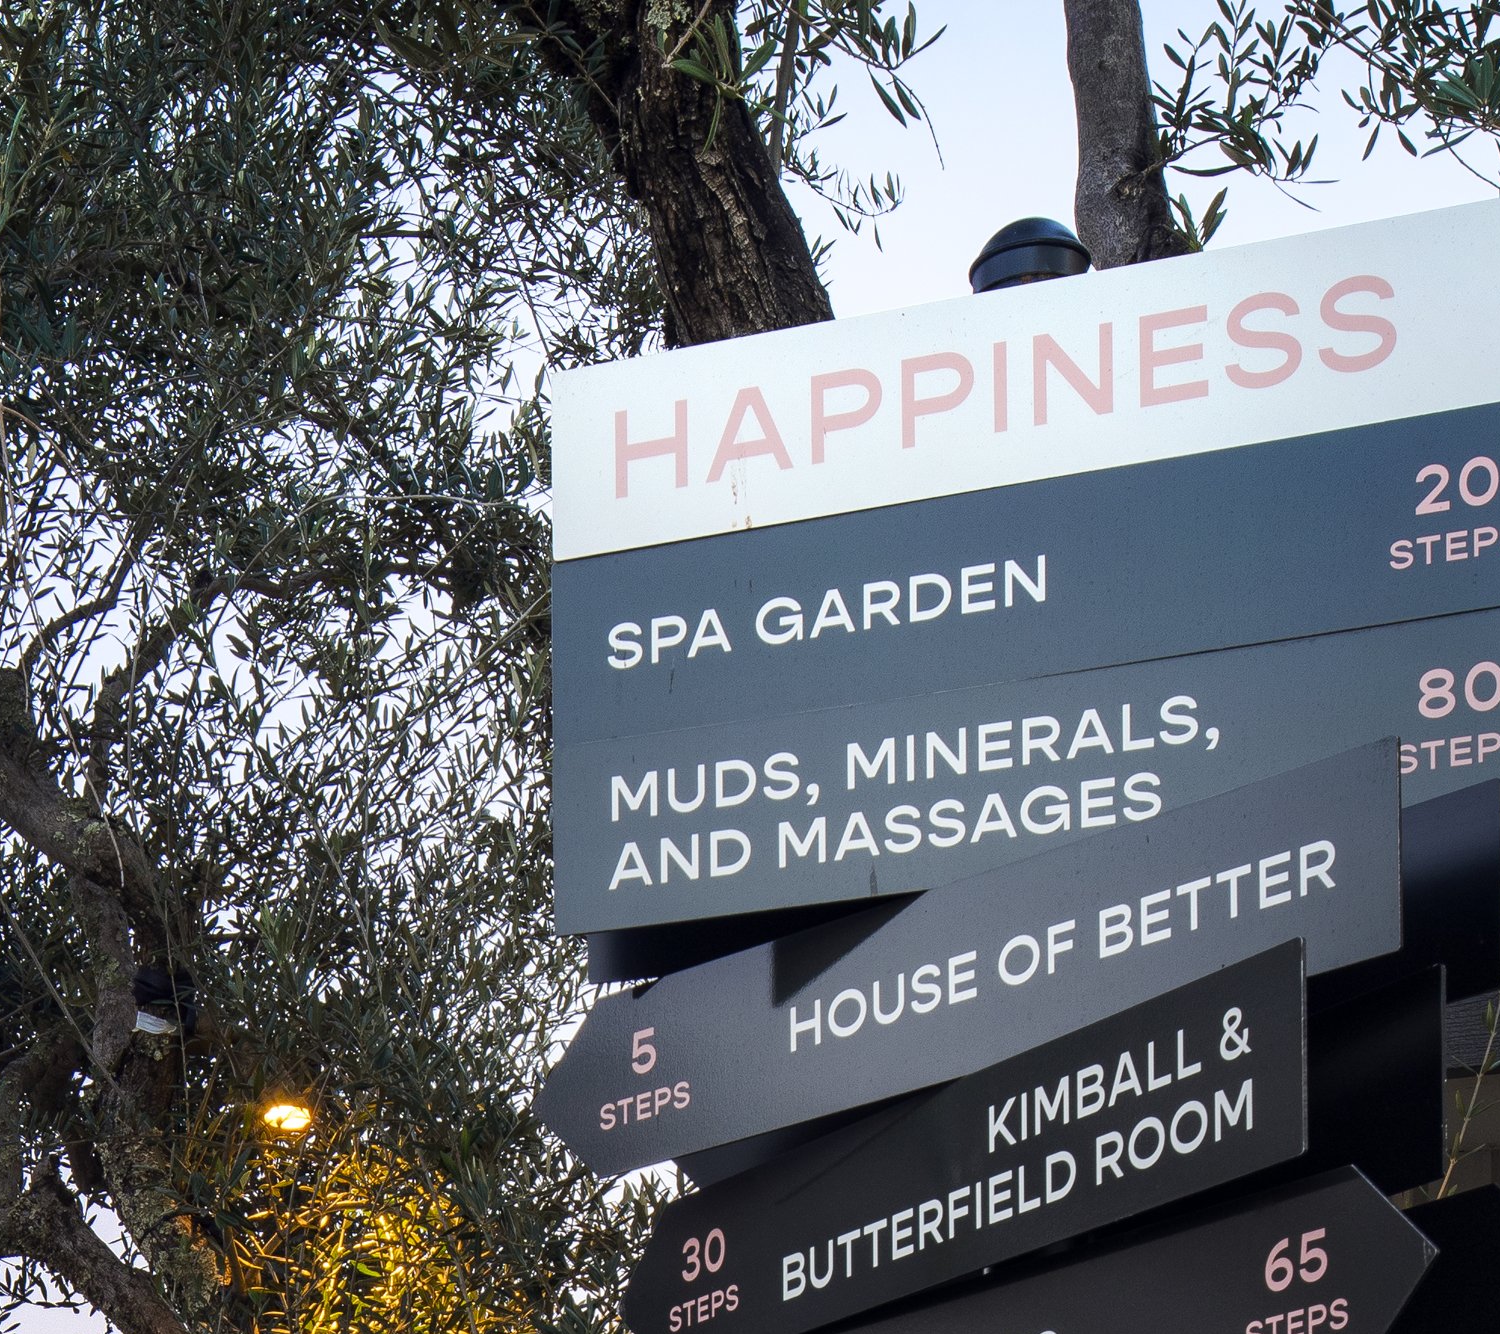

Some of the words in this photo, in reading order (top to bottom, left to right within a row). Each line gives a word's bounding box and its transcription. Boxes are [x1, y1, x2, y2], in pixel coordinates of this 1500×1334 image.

[613, 274, 1399, 499] HAPPINESS
[1415, 456, 1500, 516] 20
[607, 608, 732, 670] SPA
[755, 554, 1046, 645] GARDEN
[611, 752, 820, 822] MUDS,
[846, 695, 1220, 790] MINERALS,
[608, 829, 752, 891] AND
[778, 772, 1162, 869] MASSAGES
[789, 950, 978, 1053] HOUSE
[997, 919, 1076, 986] OF
[1098, 838, 1336, 959] BETTER
[599, 1081, 691, 1131] STEPS
[631, 1026, 657, 1075] 5
[988, 1029, 1208, 1154] KIMBALL
[1219, 1006, 1252, 1061] &
[782, 1133, 1077, 1302] BUTTERFIELD
[1095, 1078, 1253, 1186] ROOM
[669, 1284, 739, 1333] STEPS
[681, 1228, 726, 1282] 30
[1264, 1227, 1328, 1292] 65
